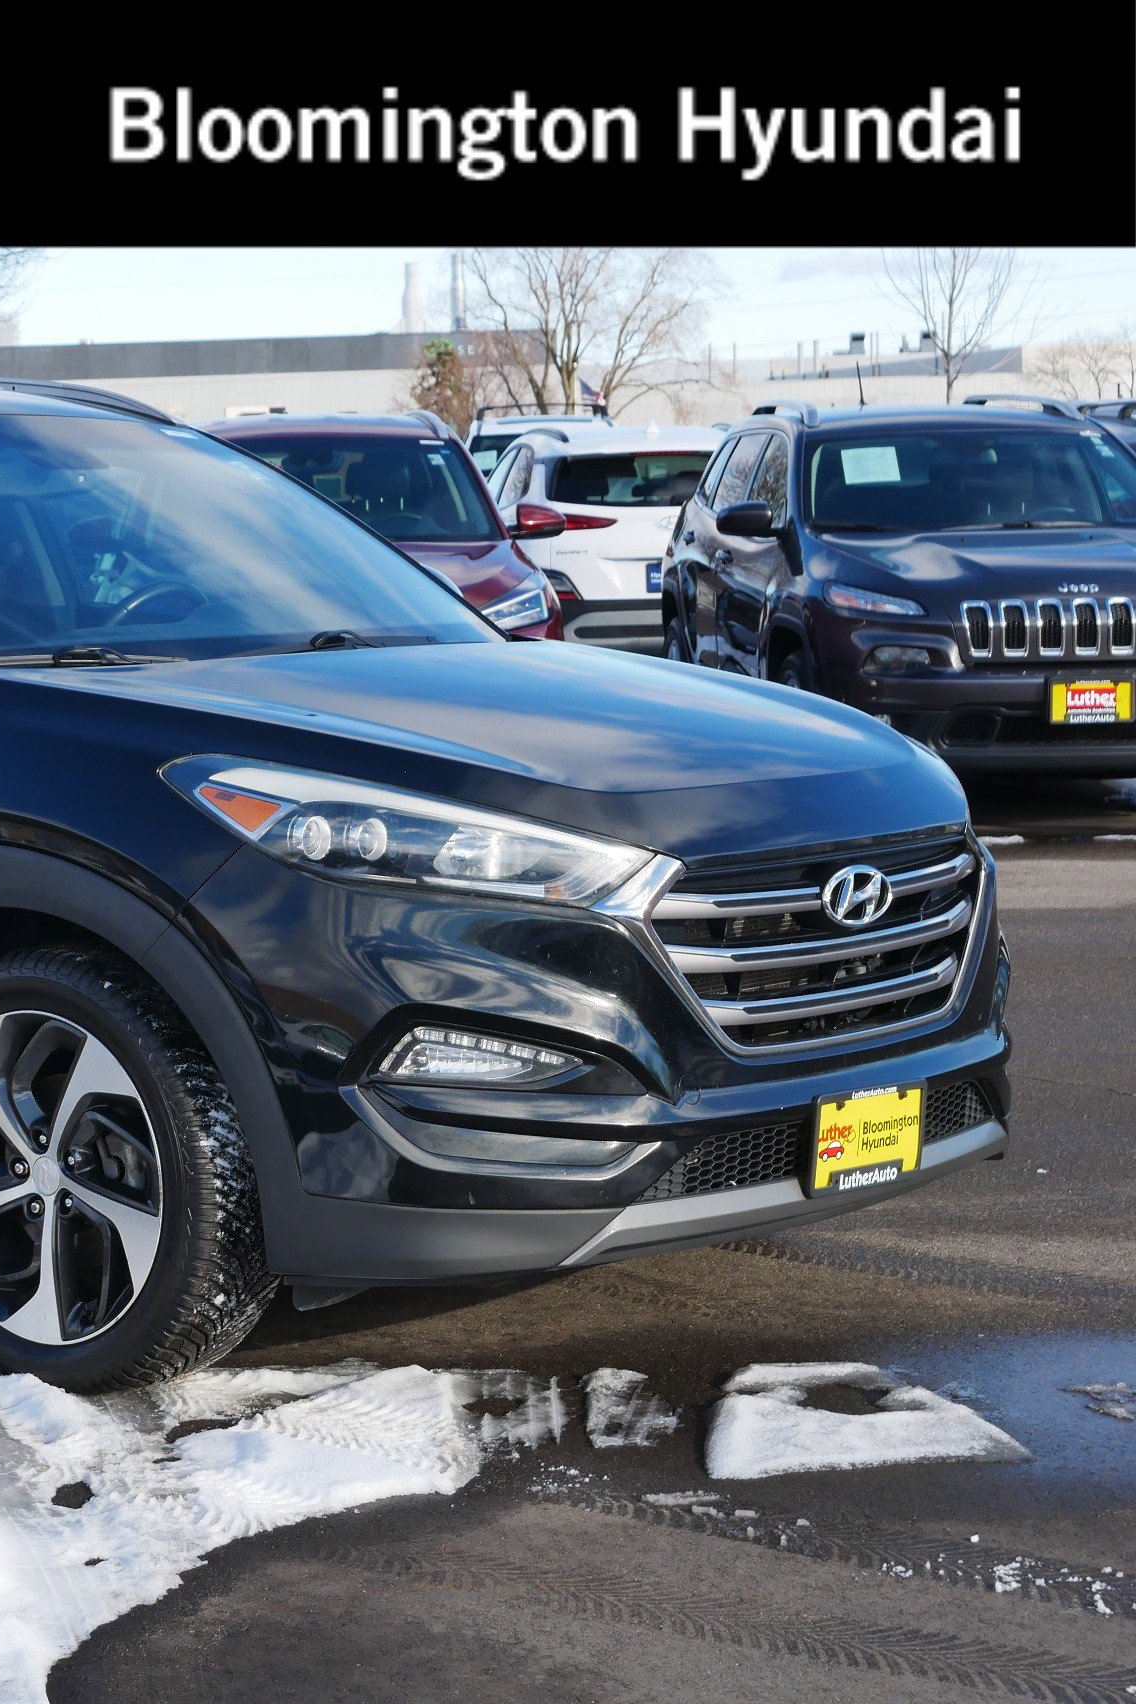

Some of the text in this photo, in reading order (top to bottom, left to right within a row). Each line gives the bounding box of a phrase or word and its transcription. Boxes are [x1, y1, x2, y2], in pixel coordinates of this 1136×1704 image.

[1058, 583, 1099, 593] Jeep
[1067, 690, 1116, 707] Luther
[1070, 714, 1115, 723] LutherAuto
[851, 1086, 898, 1099] LutherAuto.com
[862, 1114, 919, 1135] Bloomington
[861, 1131, 899, 1153] Hyundai
[839, 1165, 898, 1190] LutherAuto
